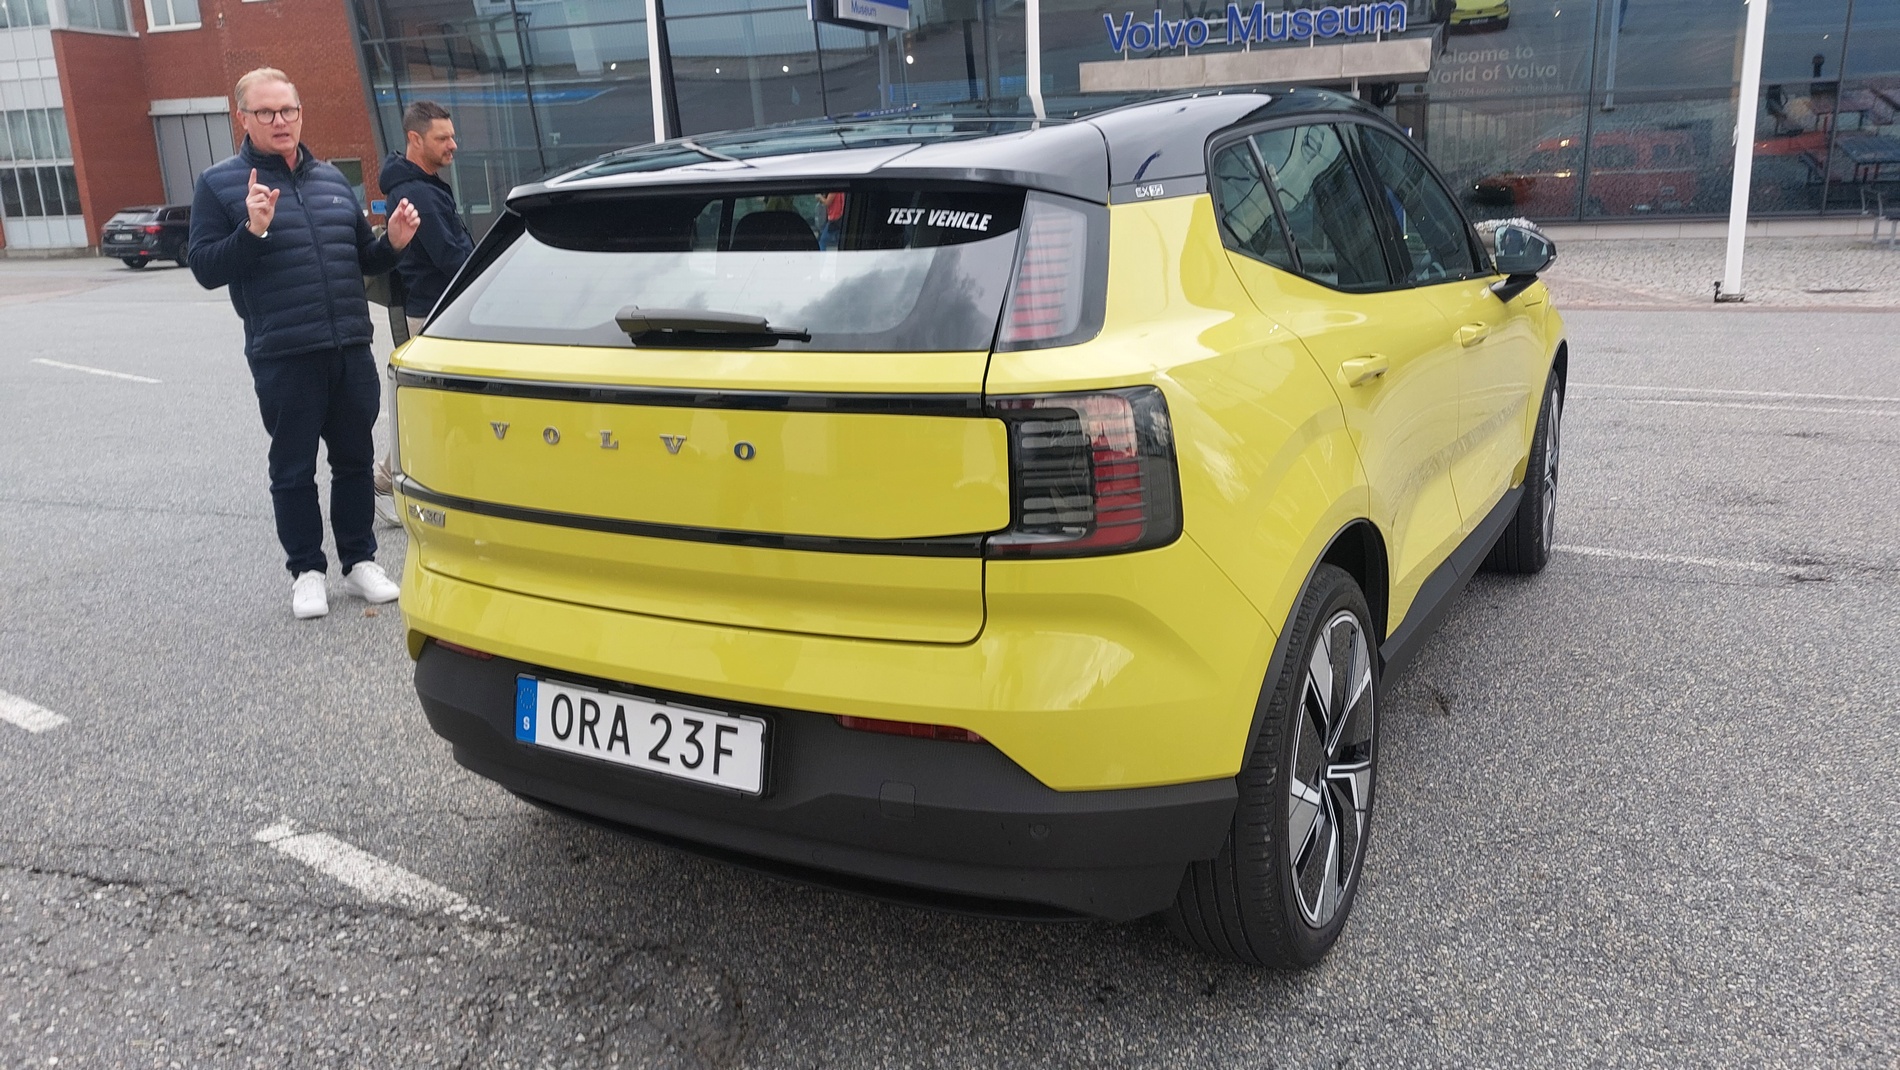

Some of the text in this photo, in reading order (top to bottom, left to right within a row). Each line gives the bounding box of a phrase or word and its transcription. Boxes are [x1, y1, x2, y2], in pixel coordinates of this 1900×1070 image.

[850, 0, 877, 16] Museum
[1103, 9, 1210, 52] Volvo
[1226, 1, 1407, 45] Museum
[1515, 45, 1534, 60] to
[1482, 64, 1501, 81] of
[1506, 63, 1557, 79] Volvo
[887, 208, 992, 232] TEST VEHICLE
[490, 421, 756, 460] VOLVO
[523, 693, 738, 776] S ORA 23F
